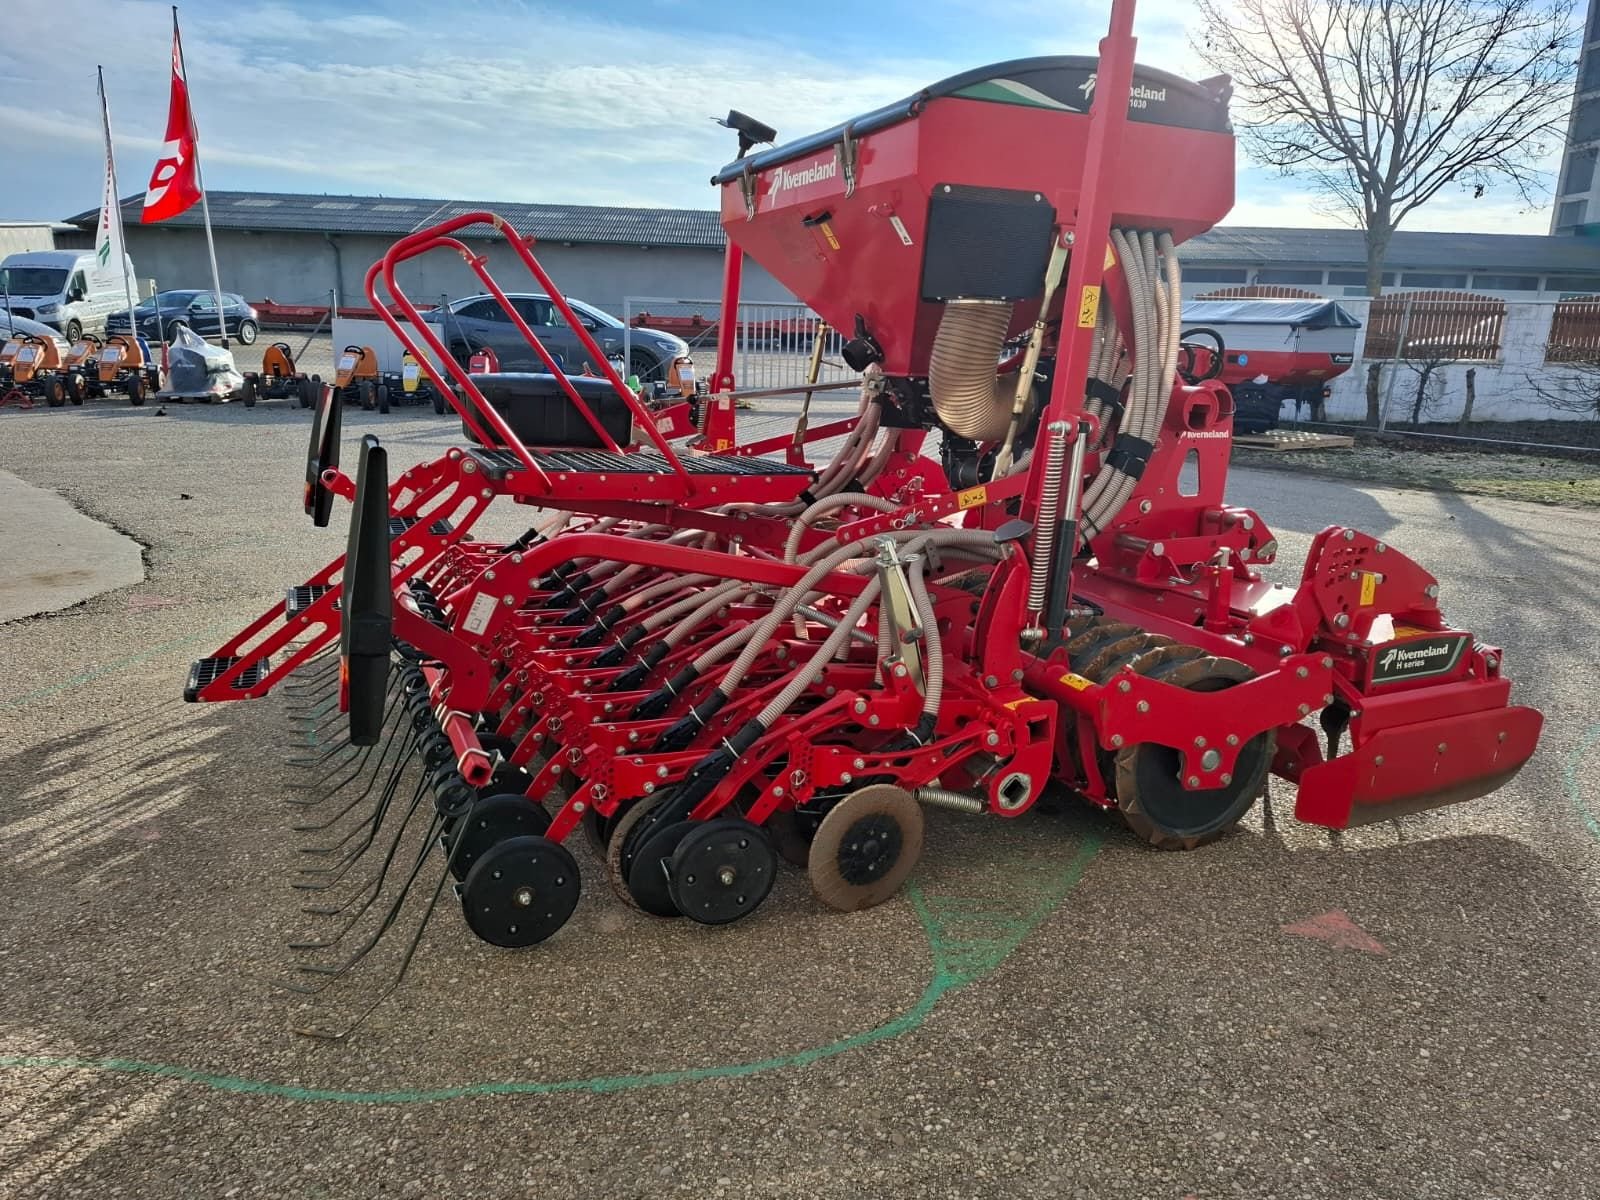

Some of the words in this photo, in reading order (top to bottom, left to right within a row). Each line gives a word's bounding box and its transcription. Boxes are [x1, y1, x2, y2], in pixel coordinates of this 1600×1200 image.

[783, 155, 837, 191] Kverneland
[1398, 643, 1449, 661] Kverneland
[1396, 661, 1403, 670] H
[1404, 659, 1425, 669] series
